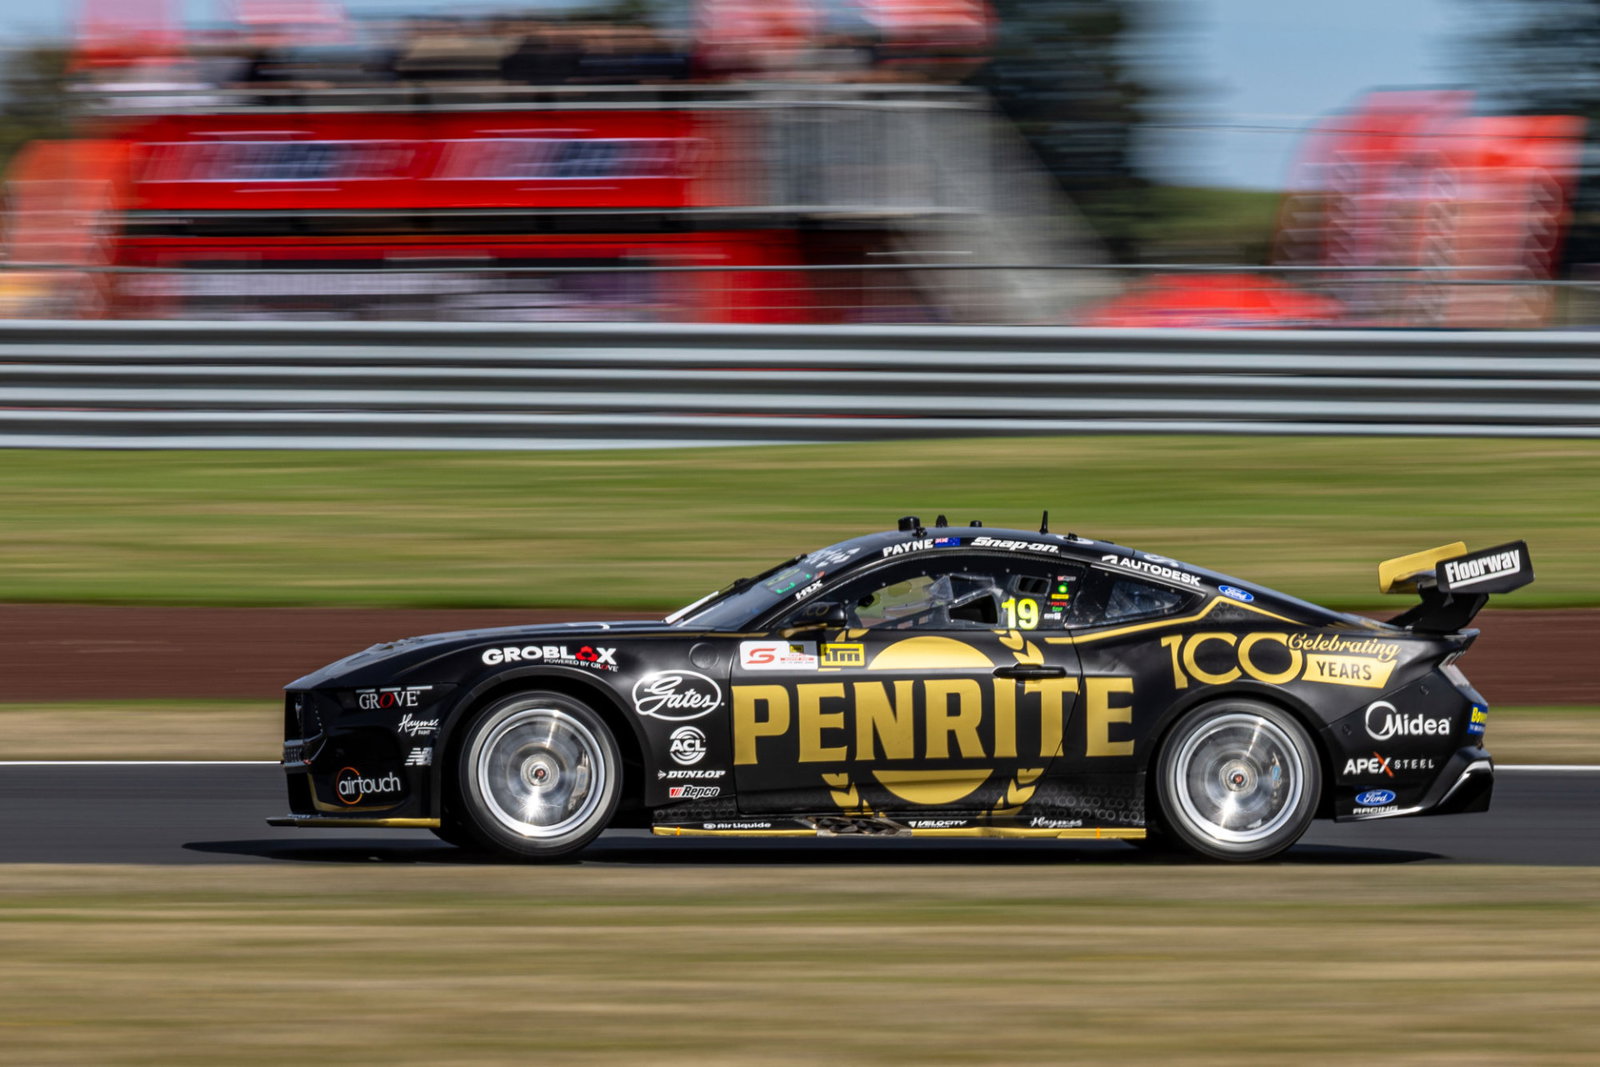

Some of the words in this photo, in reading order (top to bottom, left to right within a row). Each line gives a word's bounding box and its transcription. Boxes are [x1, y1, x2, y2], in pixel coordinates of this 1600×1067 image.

[883, 538, 934, 557] PAYNE
[1120, 557, 1201, 586] AUTODESK
[1444, 549, 1520, 583] Floorway
[1001, 595, 1039, 630] 19
[1287, 633, 1402, 661] Celebrating
[544, 657, 579, 666] POWERED
[590, 663, 618, 673] GROVE
[1161, 632, 1303, 690] 100
[1315, 660, 1372, 681] YEARS
[359, 690, 419, 709] GROVE
[636, 676, 717, 715] Gates
[398, 713, 440, 737] Haymes
[732, 677, 1136, 765] PENRITE
[1376, 712, 1450, 736] Midea
[669, 739, 706, 752] ACL
[666, 770, 726, 779] DUNLOP
[1343, 752, 1395, 778] APEX
[1394, 758, 1435, 769] STEEL
[338, 771, 401, 796] airtouch
[682, 785, 719, 799] Repco
[1363, 790, 1388, 804] Ford
[1353, 805, 1399, 815] RACING
[917, 819, 968, 827] VELOCITY
